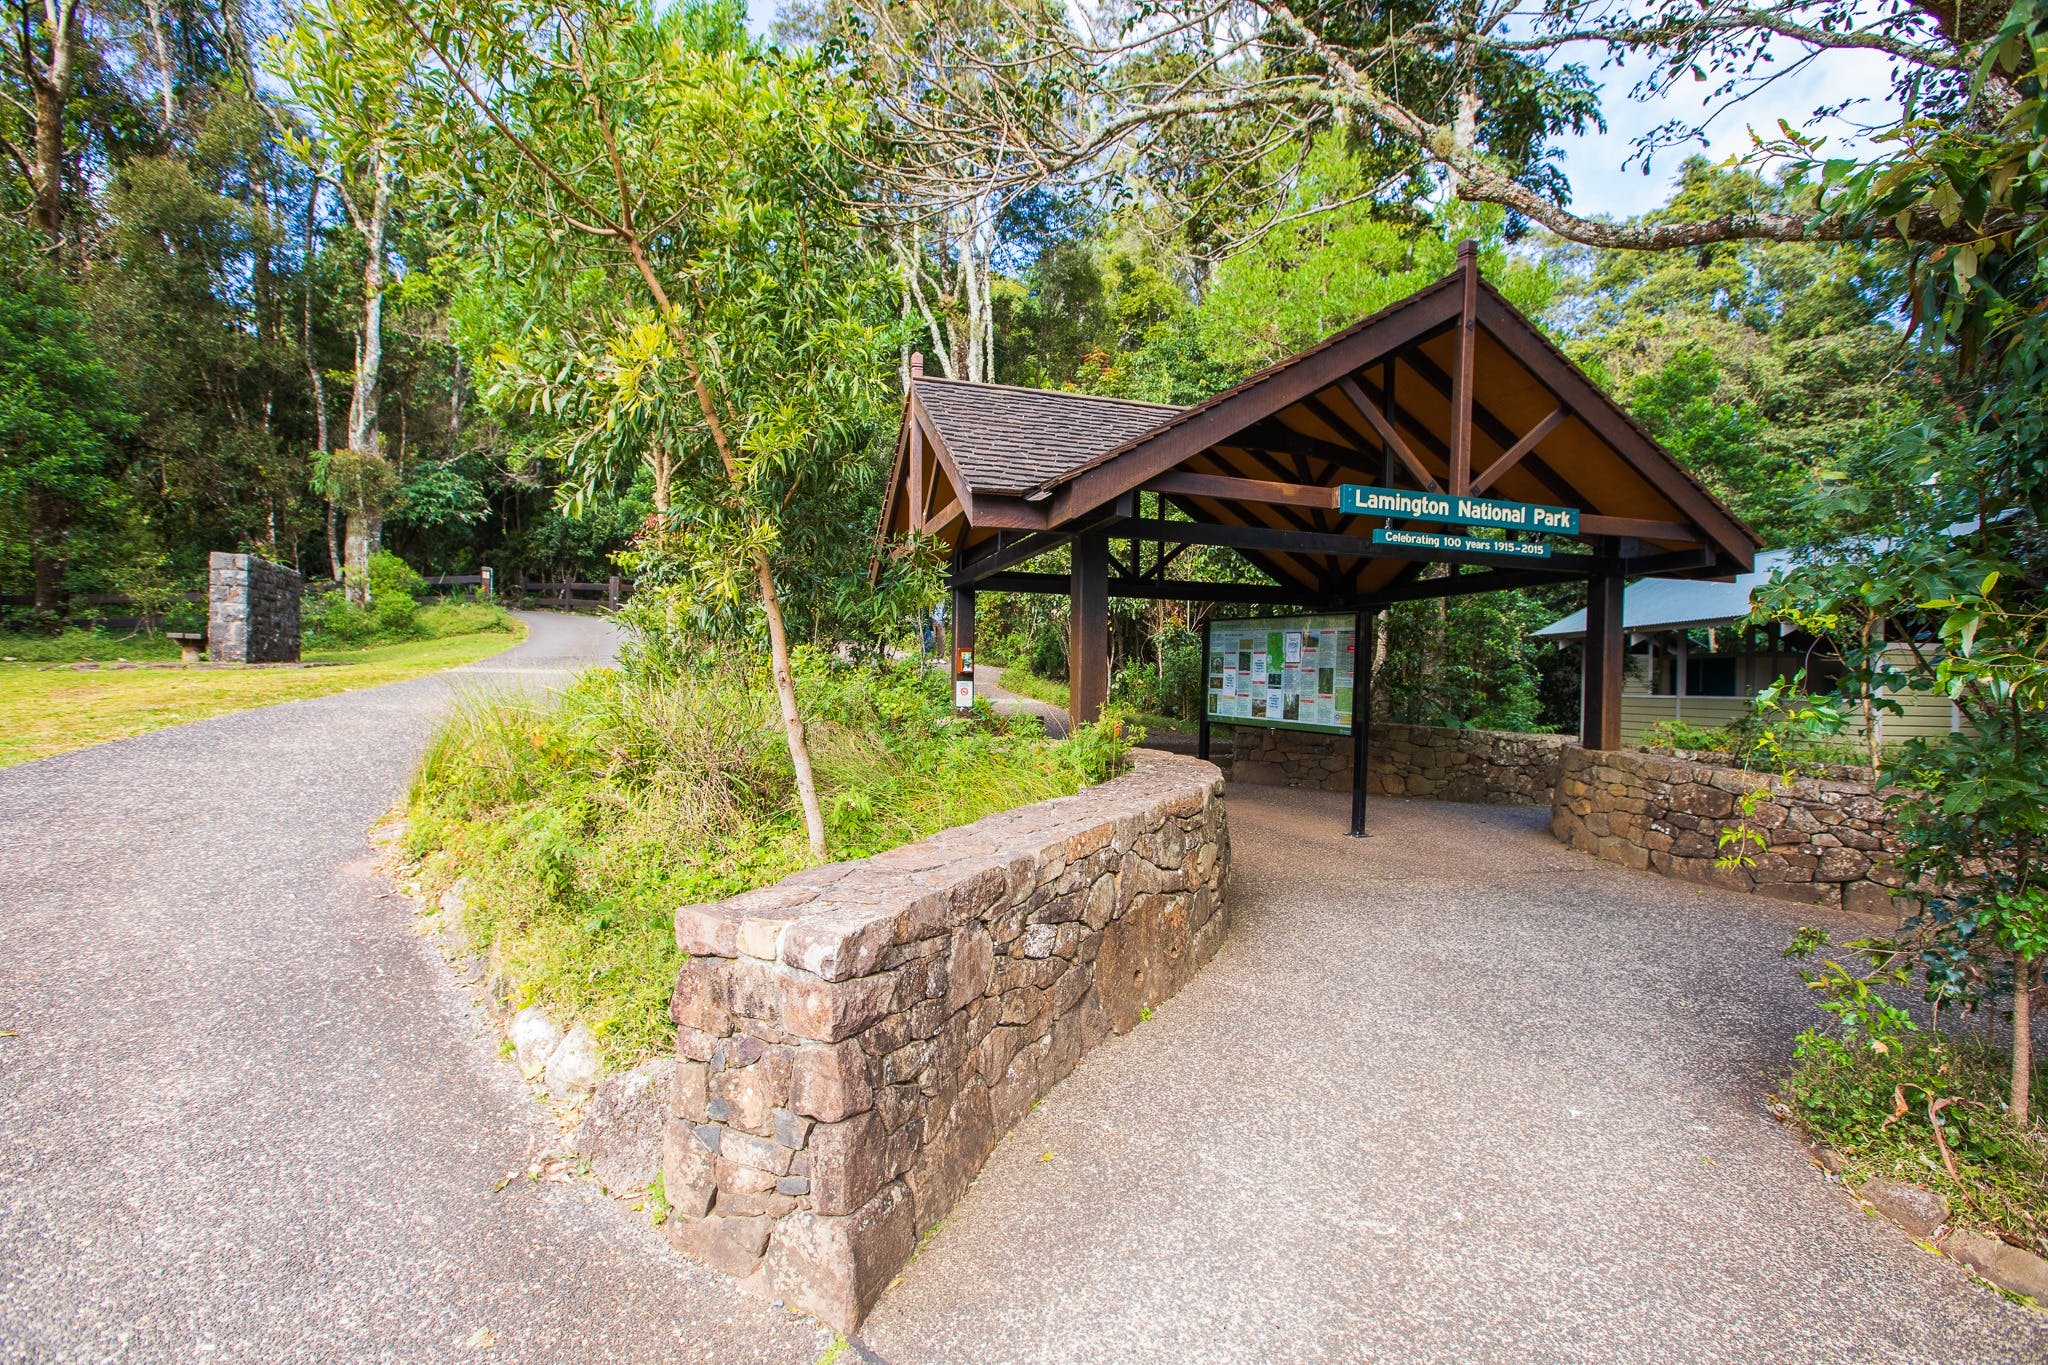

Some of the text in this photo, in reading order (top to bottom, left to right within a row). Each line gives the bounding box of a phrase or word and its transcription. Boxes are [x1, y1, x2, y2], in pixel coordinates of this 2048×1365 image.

[1355, 489, 1571, 527] Lamington National Park
[1385, 531, 1544, 554] Celebrating 100 years 1915-2015
